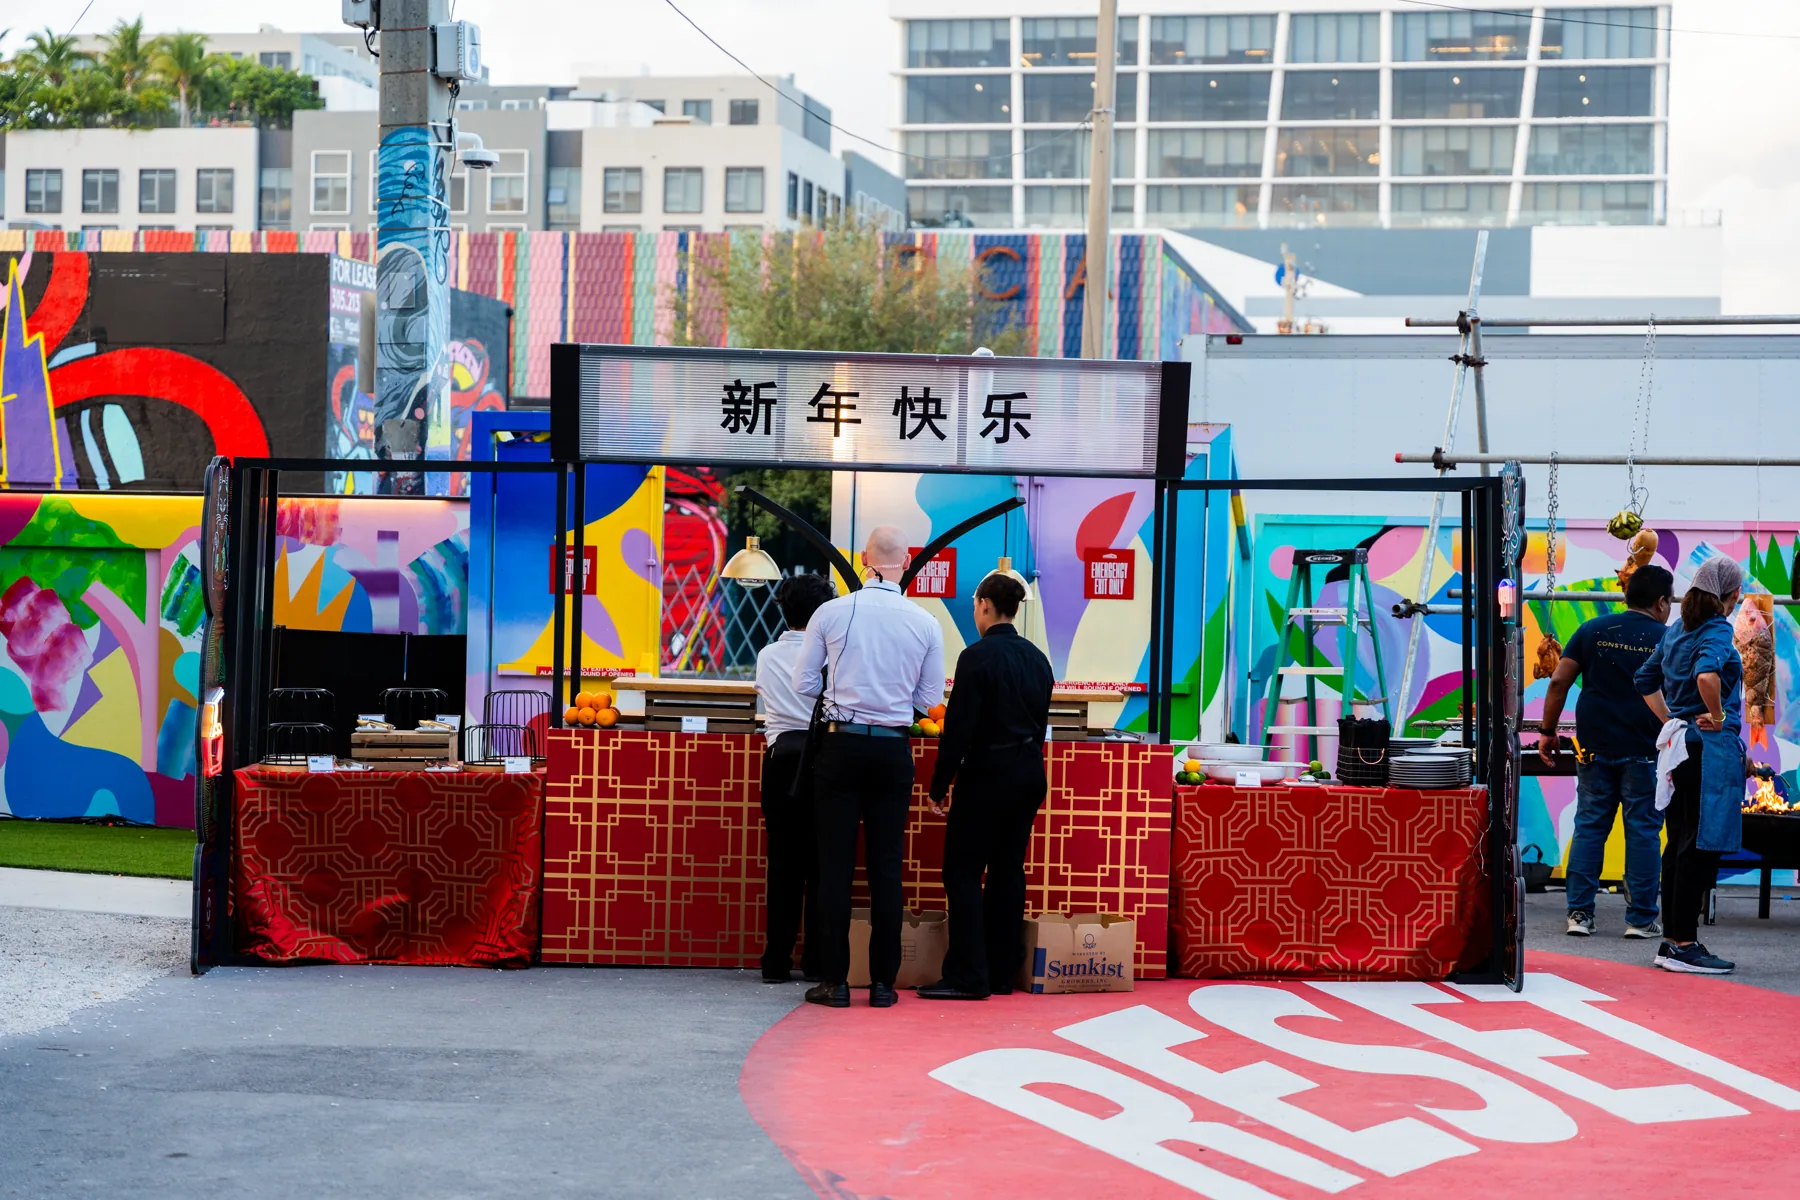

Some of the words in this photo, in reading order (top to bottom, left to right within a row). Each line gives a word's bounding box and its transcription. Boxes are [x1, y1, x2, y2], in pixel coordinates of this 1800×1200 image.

[333, 258, 350, 283] FOR
[331, 288, 360, 313] 305.213
[720, 379, 1032, 444] 新年快乐
[915, 560, 950, 577] ERGENCY
[1091, 562, 1128, 579] EMERGENCY
[916, 577, 930, 593] EXIT
[931, 577, 946, 593] ONLY
[1094, 579, 1107, 595] EXIT
[1109, 579, 1125, 595] ONLY
[1047, 957, 1124, 979] Sunkist
[928, 972, 1800, 1200] RESET
